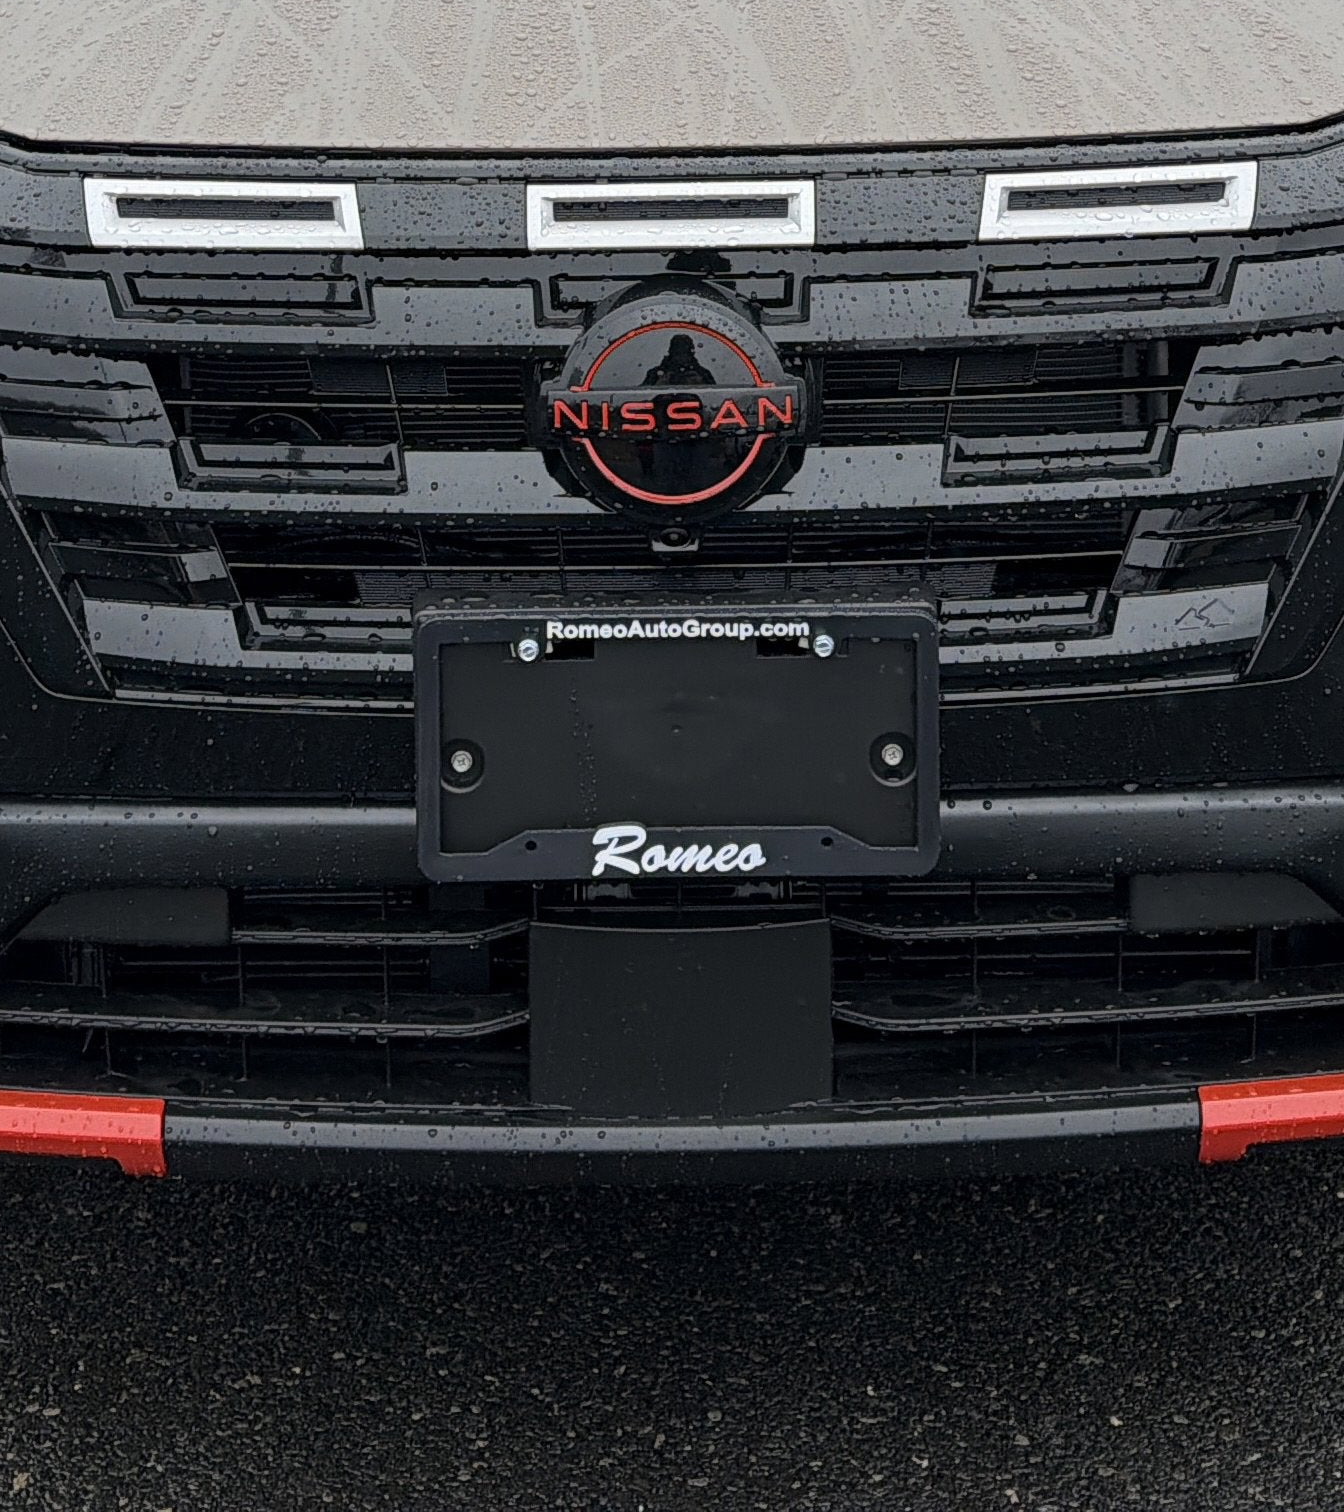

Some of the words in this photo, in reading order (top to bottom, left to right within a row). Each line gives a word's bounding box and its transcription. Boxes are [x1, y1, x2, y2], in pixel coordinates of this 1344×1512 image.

[553, 394, 793, 431] NISSAN
[546, 619, 810, 641] RomeoAutoGroup.com
[591, 824, 767, 877] Romeo
